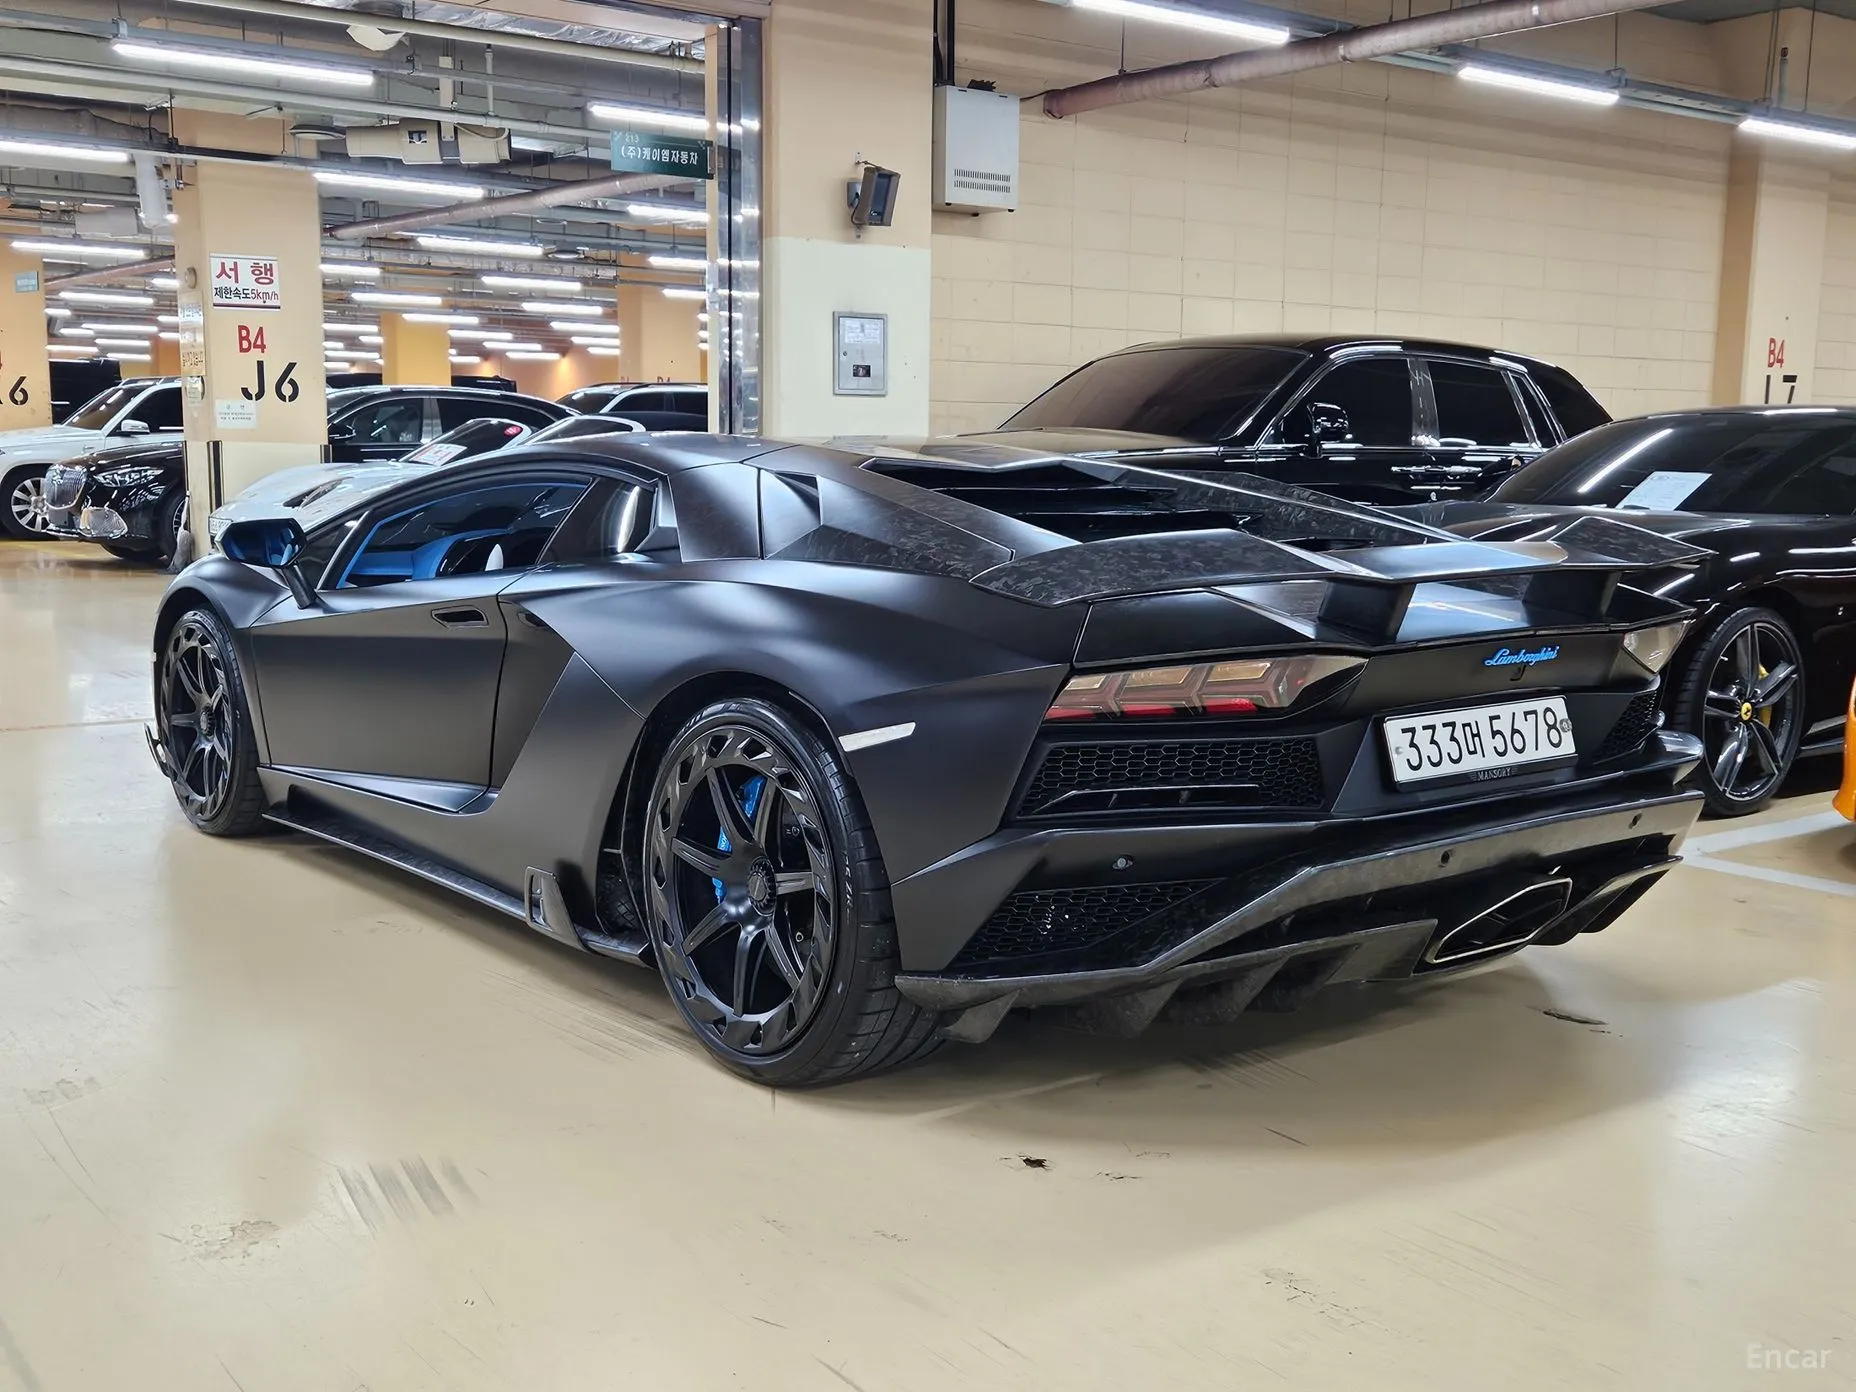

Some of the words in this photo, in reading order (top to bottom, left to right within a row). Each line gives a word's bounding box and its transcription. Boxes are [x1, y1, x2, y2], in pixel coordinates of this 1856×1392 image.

[238, 325, 266, 353] B4
[1768, 337, 1785, 368] B4
[1484, 646, 1560, 667] Lamborghini
[1401, 720, 1486, 772] 333머
[1488, 707, 1562, 758] 5678
[1478, 767, 1511, 781] MANSORY
